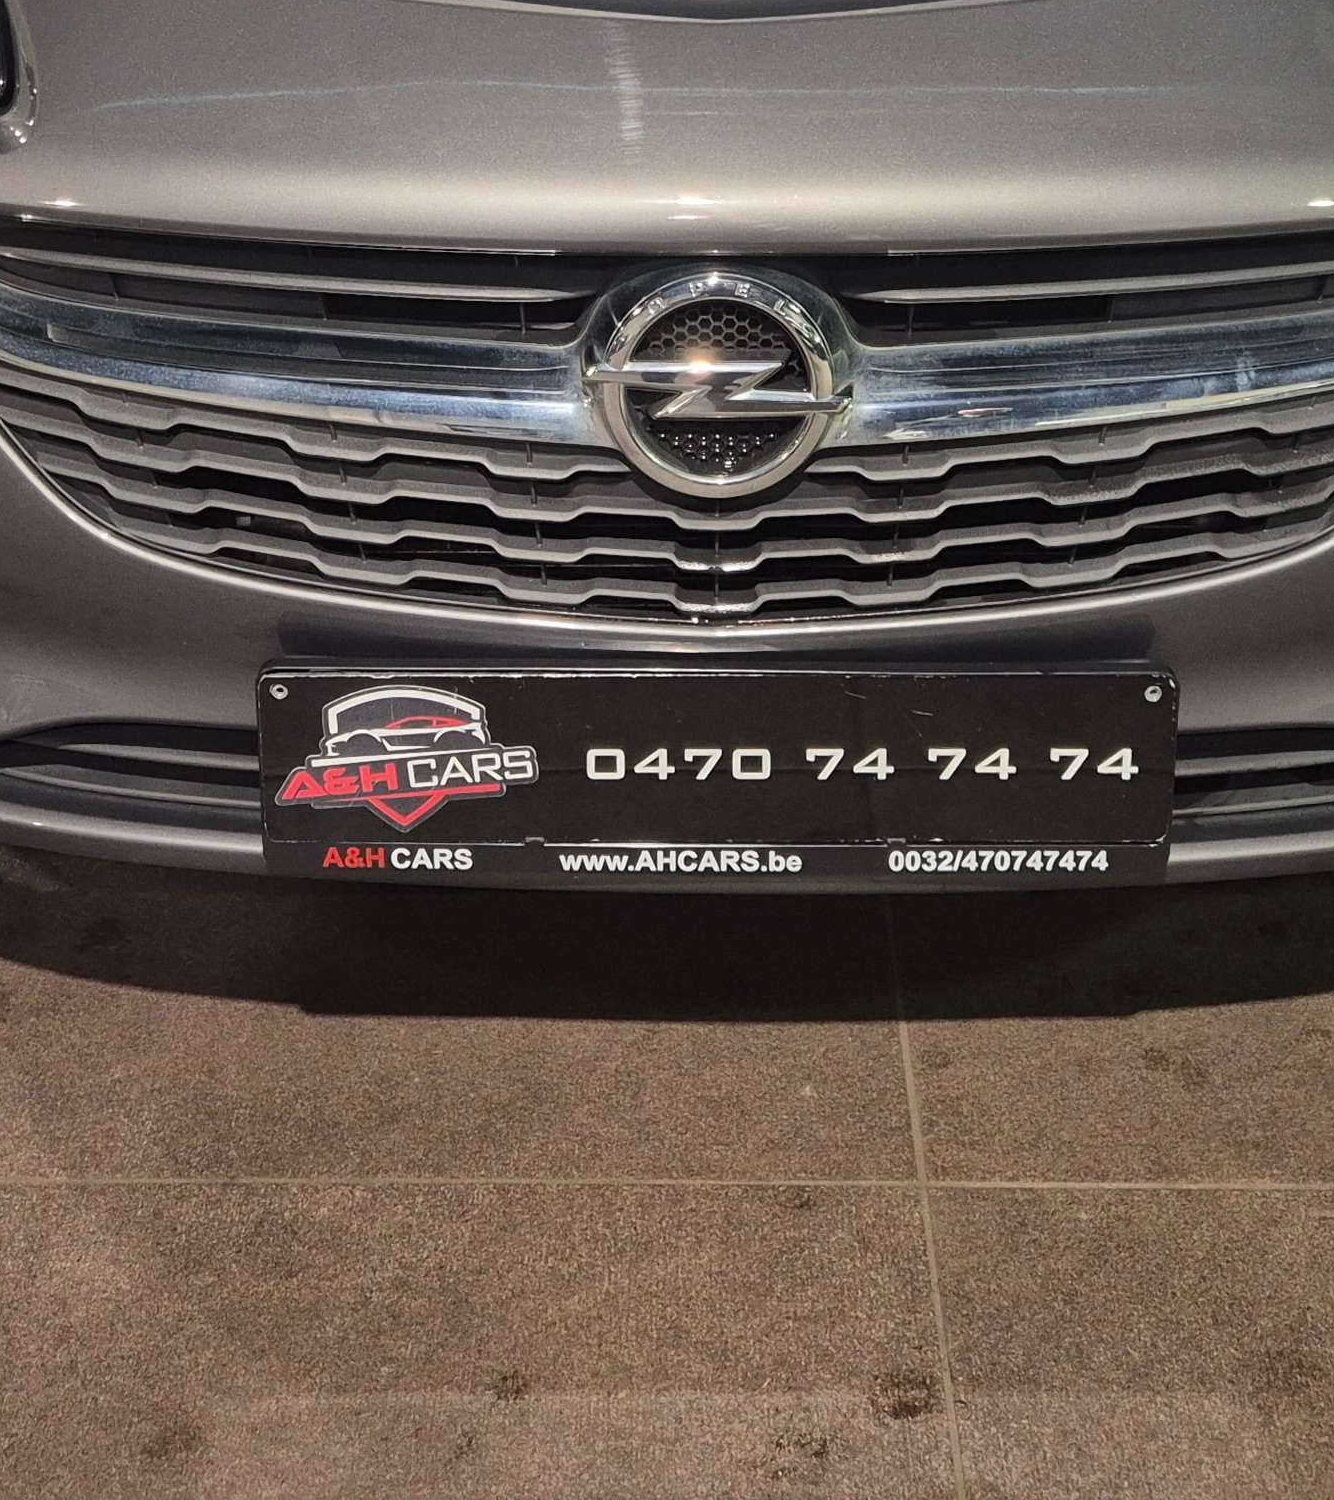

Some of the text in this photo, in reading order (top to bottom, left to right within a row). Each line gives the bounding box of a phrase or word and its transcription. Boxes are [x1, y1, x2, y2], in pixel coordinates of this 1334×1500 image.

[647, 282, 786, 315] OPEL
[282, 750, 534, 800] A&H CARS
[586, 748, 1139, 780] 0470 74 74 74
[323, 847, 474, 871] A&H CARS
[559, 850, 803, 872] www.AHCARS.be
[888, 850, 1109, 872] 0032/470747474
